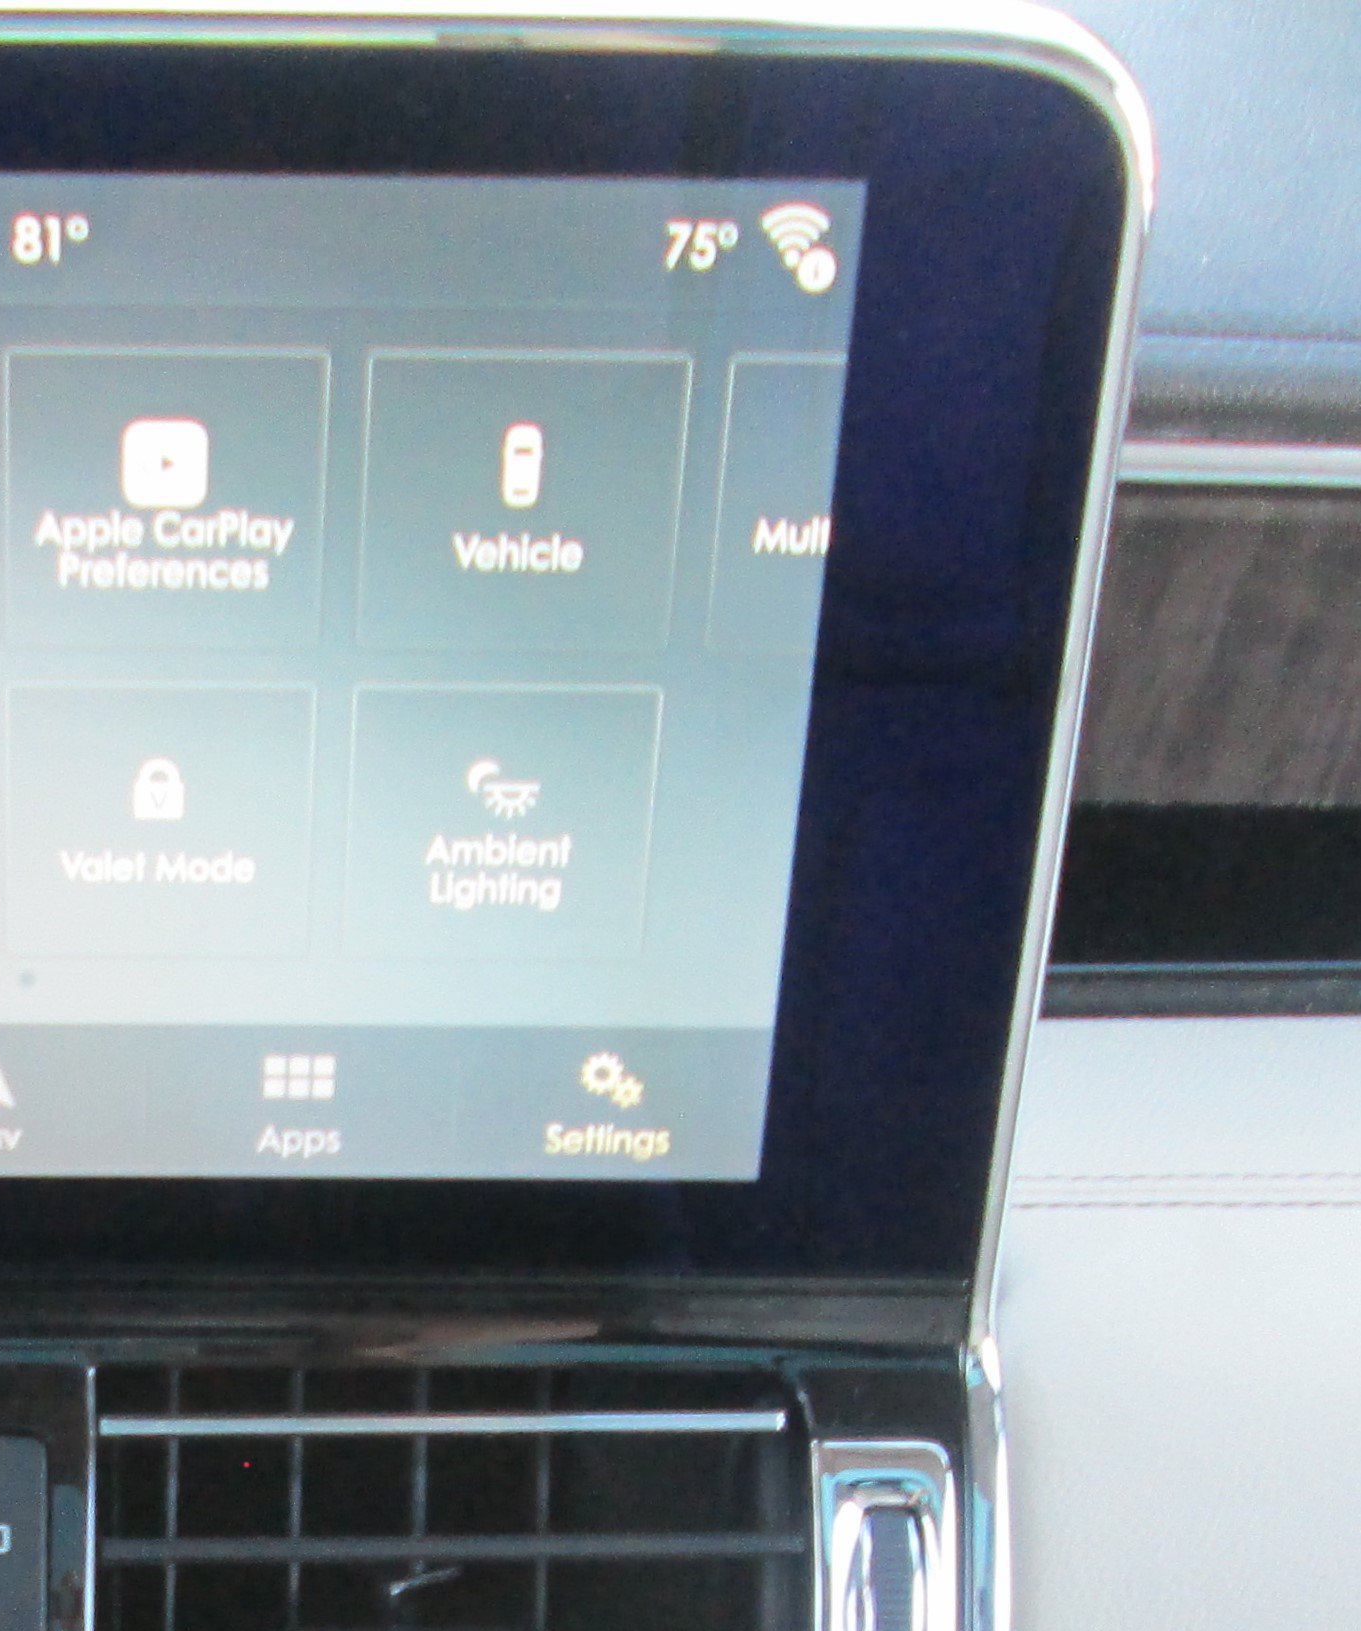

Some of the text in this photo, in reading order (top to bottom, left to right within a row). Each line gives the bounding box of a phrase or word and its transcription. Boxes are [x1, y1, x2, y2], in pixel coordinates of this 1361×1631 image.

[35, 512, 294, 556] Apple CarPlay
[454, 532, 583, 573] Vehicle
[57, 551, 270, 591] Preferences
[60, 851, 255, 884] Valet Mode
[426, 834, 571, 869] Ambient
[429, 872, 562, 911] Lighting
[256, 1125, 341, 1158] Apps
[545, 1122, 670, 1159] Settings
